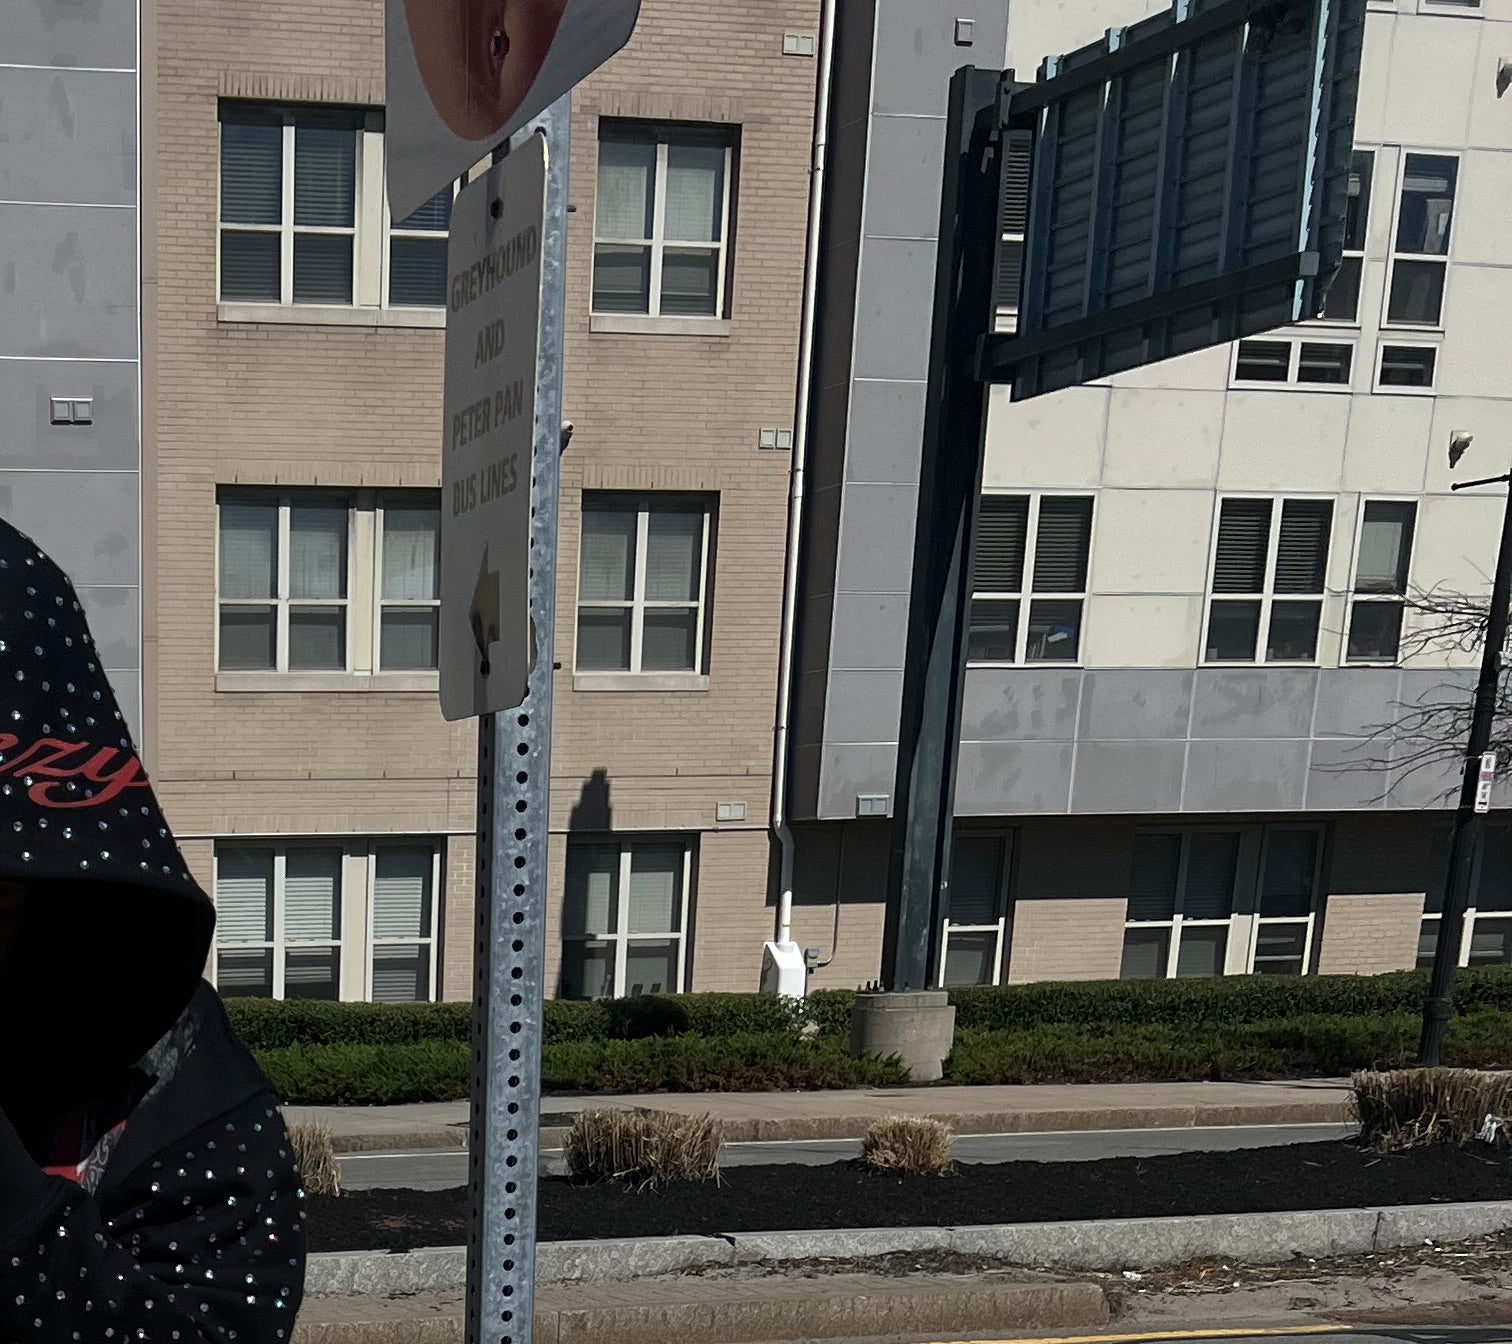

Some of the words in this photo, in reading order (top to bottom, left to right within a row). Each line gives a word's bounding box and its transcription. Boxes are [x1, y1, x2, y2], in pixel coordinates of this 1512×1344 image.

[451, 225, 537, 313] GREYHOUND
[474, 318, 505, 369] AND
[452, 396, 491, 450] PETER
[494, 378, 524, 428] PAN
[453, 472, 477, 518] BUS
[480, 452, 518, 505] LINES
